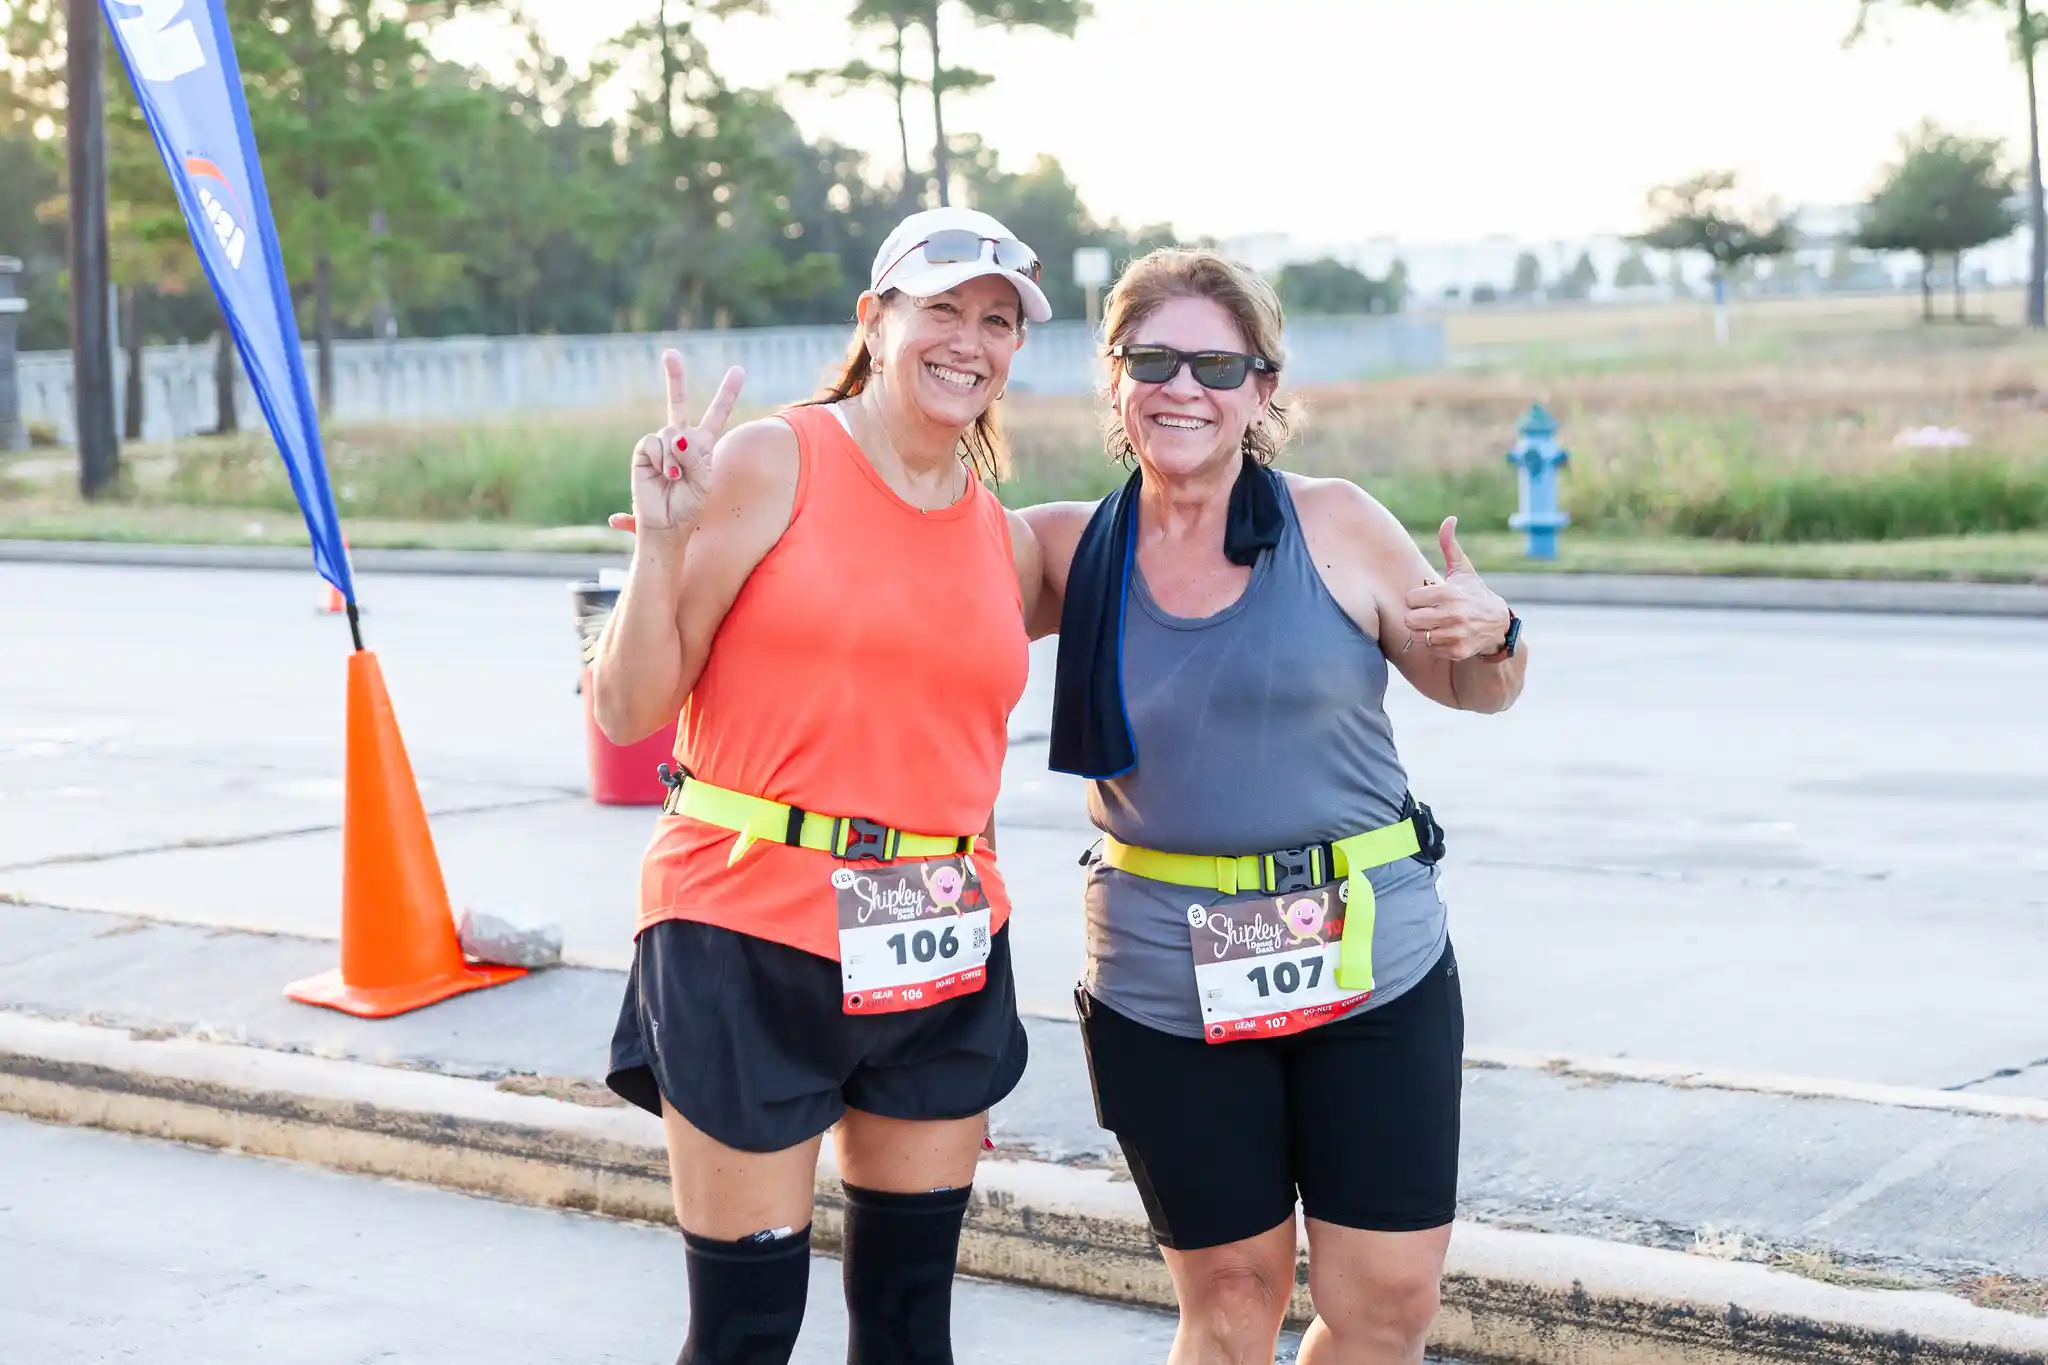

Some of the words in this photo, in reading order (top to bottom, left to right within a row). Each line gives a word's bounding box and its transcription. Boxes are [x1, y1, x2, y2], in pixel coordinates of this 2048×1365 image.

[853, 876, 925, 923] Shipley
[1191, 907, 1203, 926] 13.1
[887, 925, 959, 965] 106
[1207, 913, 1283, 959] Shipley
[1251, 940, 1274, 949] Donut
[1255, 946, 1275, 955] Dash
[1246, 956, 1324, 998] 107
[872, 990, 894, 999] GEAR
[902, 989, 923, 1001] 106
[1234, 1020, 1257, 1030] GEAR
[1265, 1016, 1288, 1029] 107
[1303, 1005, 1333, 1016] DO-NUT
